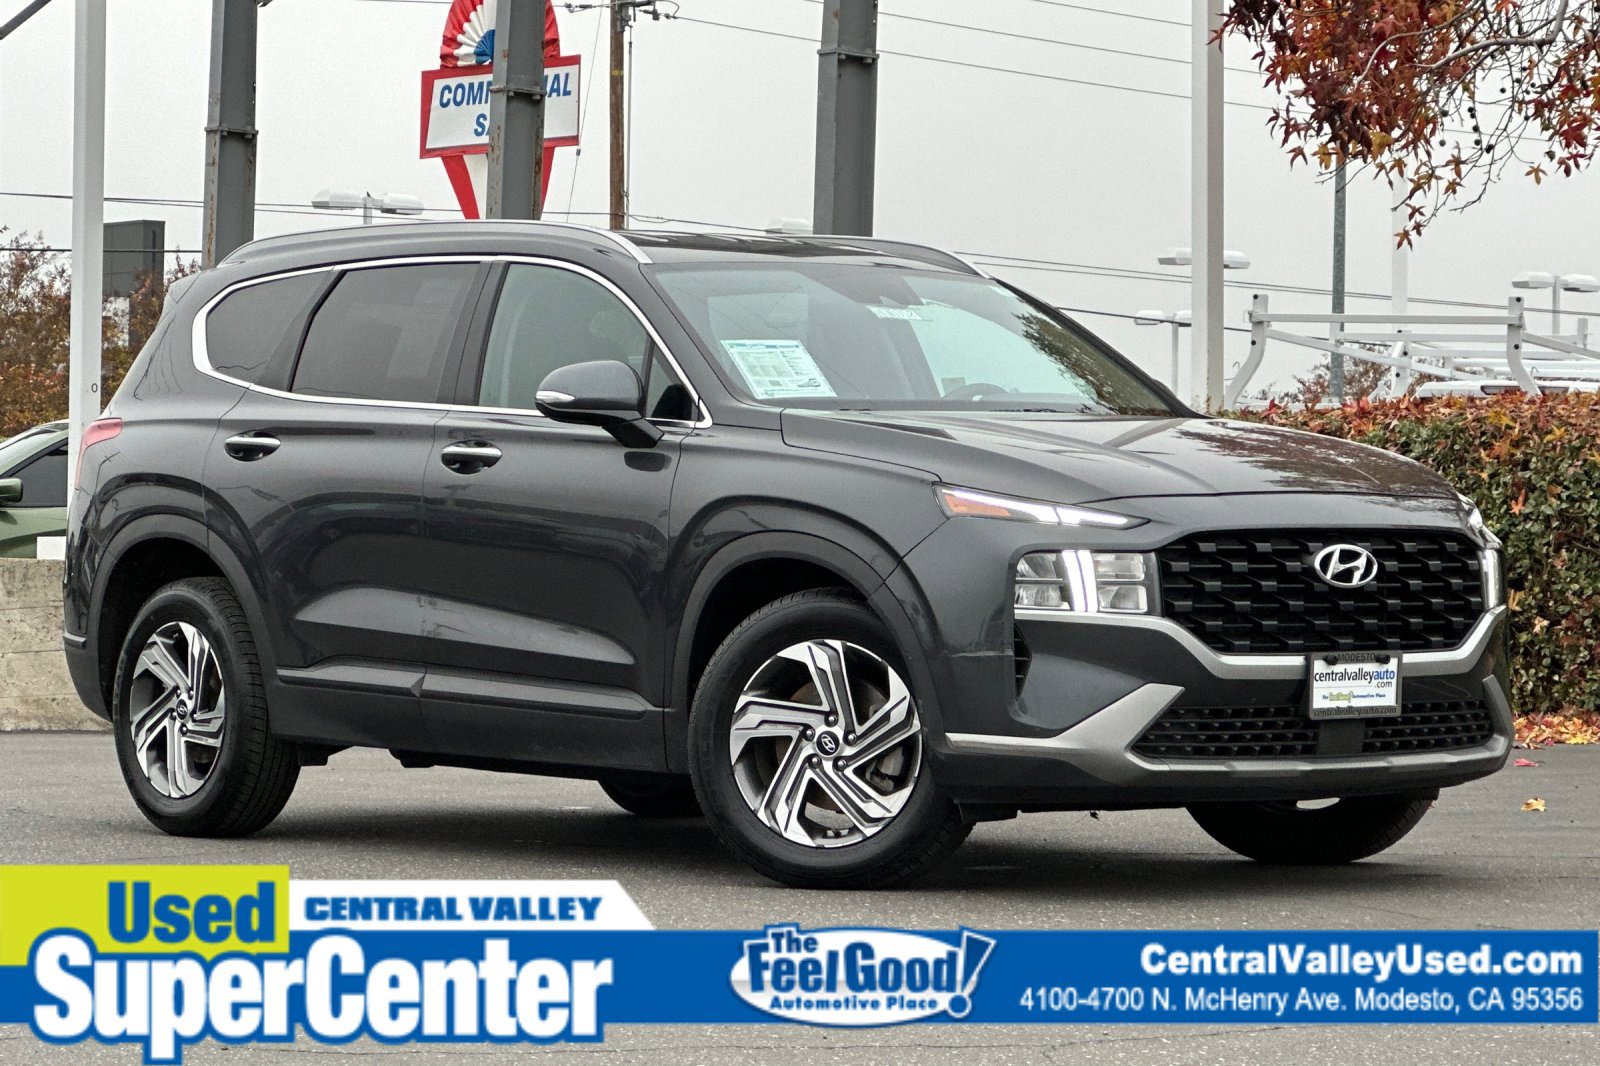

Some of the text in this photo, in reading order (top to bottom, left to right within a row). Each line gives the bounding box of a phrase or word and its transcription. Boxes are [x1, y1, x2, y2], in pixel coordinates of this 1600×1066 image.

[1337, 652, 1376, 662] MODESTO
[1314, 667, 1396, 685] centralvalleyauto
[1374, 681, 1393, 689] .com
[1313, 705, 1397, 717] centralvalleyauto.com
